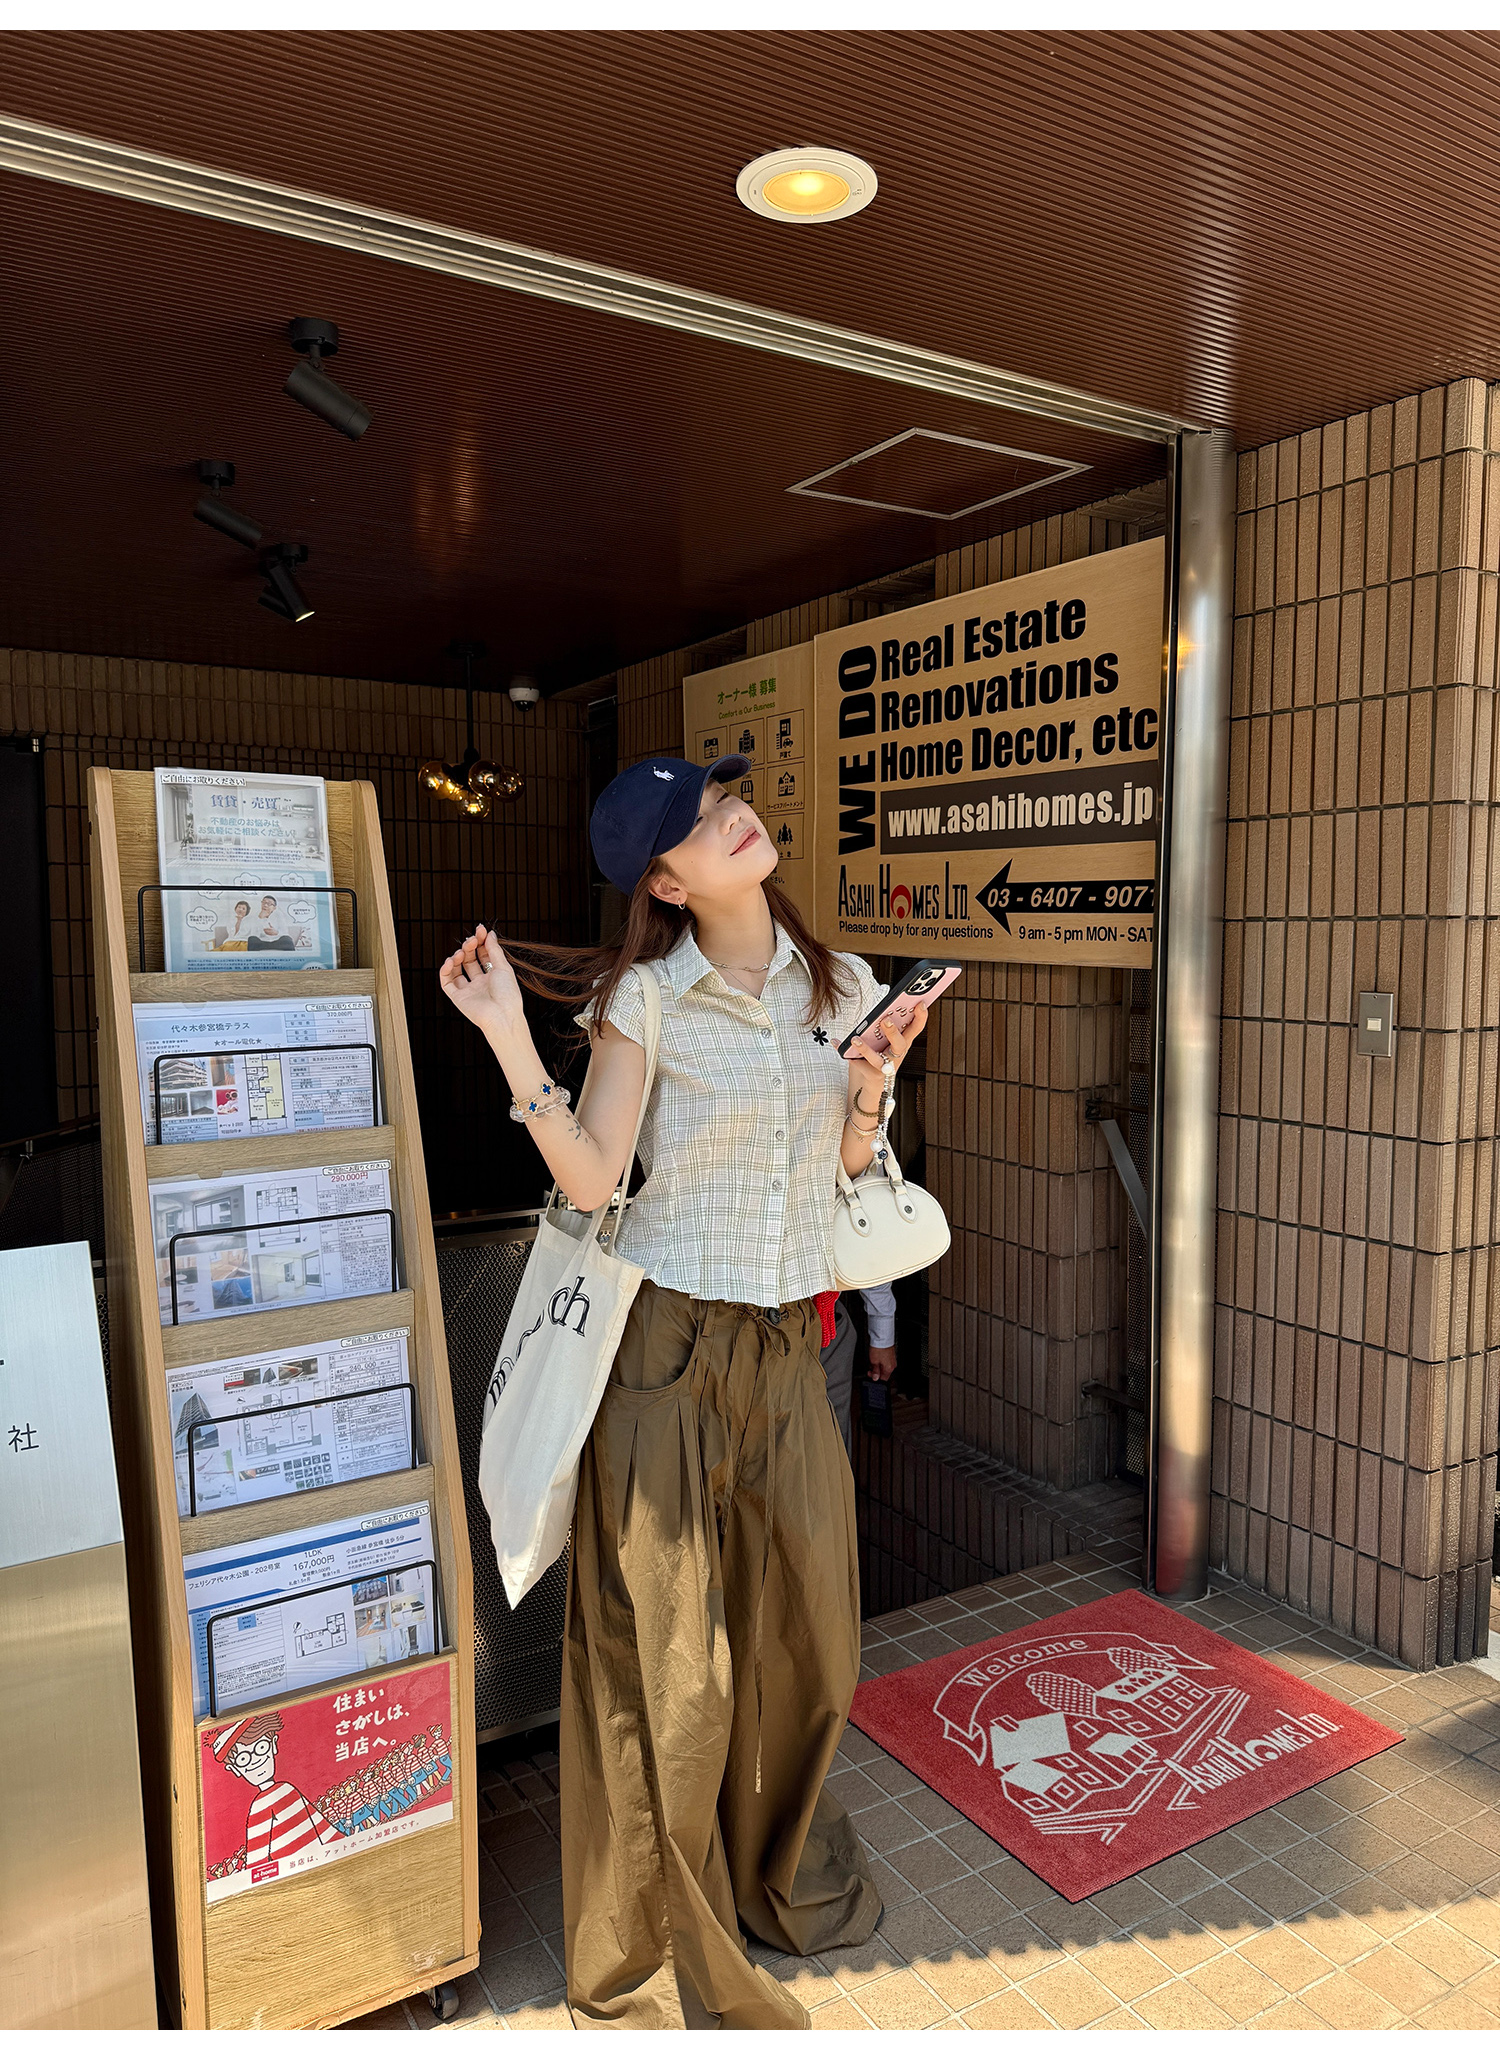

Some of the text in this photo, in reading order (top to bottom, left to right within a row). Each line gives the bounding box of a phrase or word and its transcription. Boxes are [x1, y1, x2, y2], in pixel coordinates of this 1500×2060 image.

[881, 599, 1086, 682] Real Estate
[717, 682, 757, 705] オーナー様
[881, 653, 1119, 733] Renovations
[743, 706, 752, 714] Our
[753, 701, 776, 712] Business
[838, 645, 877, 855] WE DO
[881, 706, 1158, 783] Home Decor, etc
[211, 817, 280, 827] 不動産のお悩みは
[888, 782, 1153, 838] www.asahihomes.jp
[987, 888, 1011, 907] 03
[1030, 887, 1082, 907] 6407
[839, 920, 994, 940] Please drop by for any questions
[1086, 926, 1117, 941] MON
[7, 1422, 40, 1453] 社
[293, 1554, 335, 1571] 167,000円
[304, 1548, 323, 1558] 1LDK
[956, 1639, 1089, 1688] Welcome
[333, 1688, 384, 1714] 住まい
[335, 1703, 410, 1736] さがしは、
[335, 1736, 397, 1763] 当店へ。
